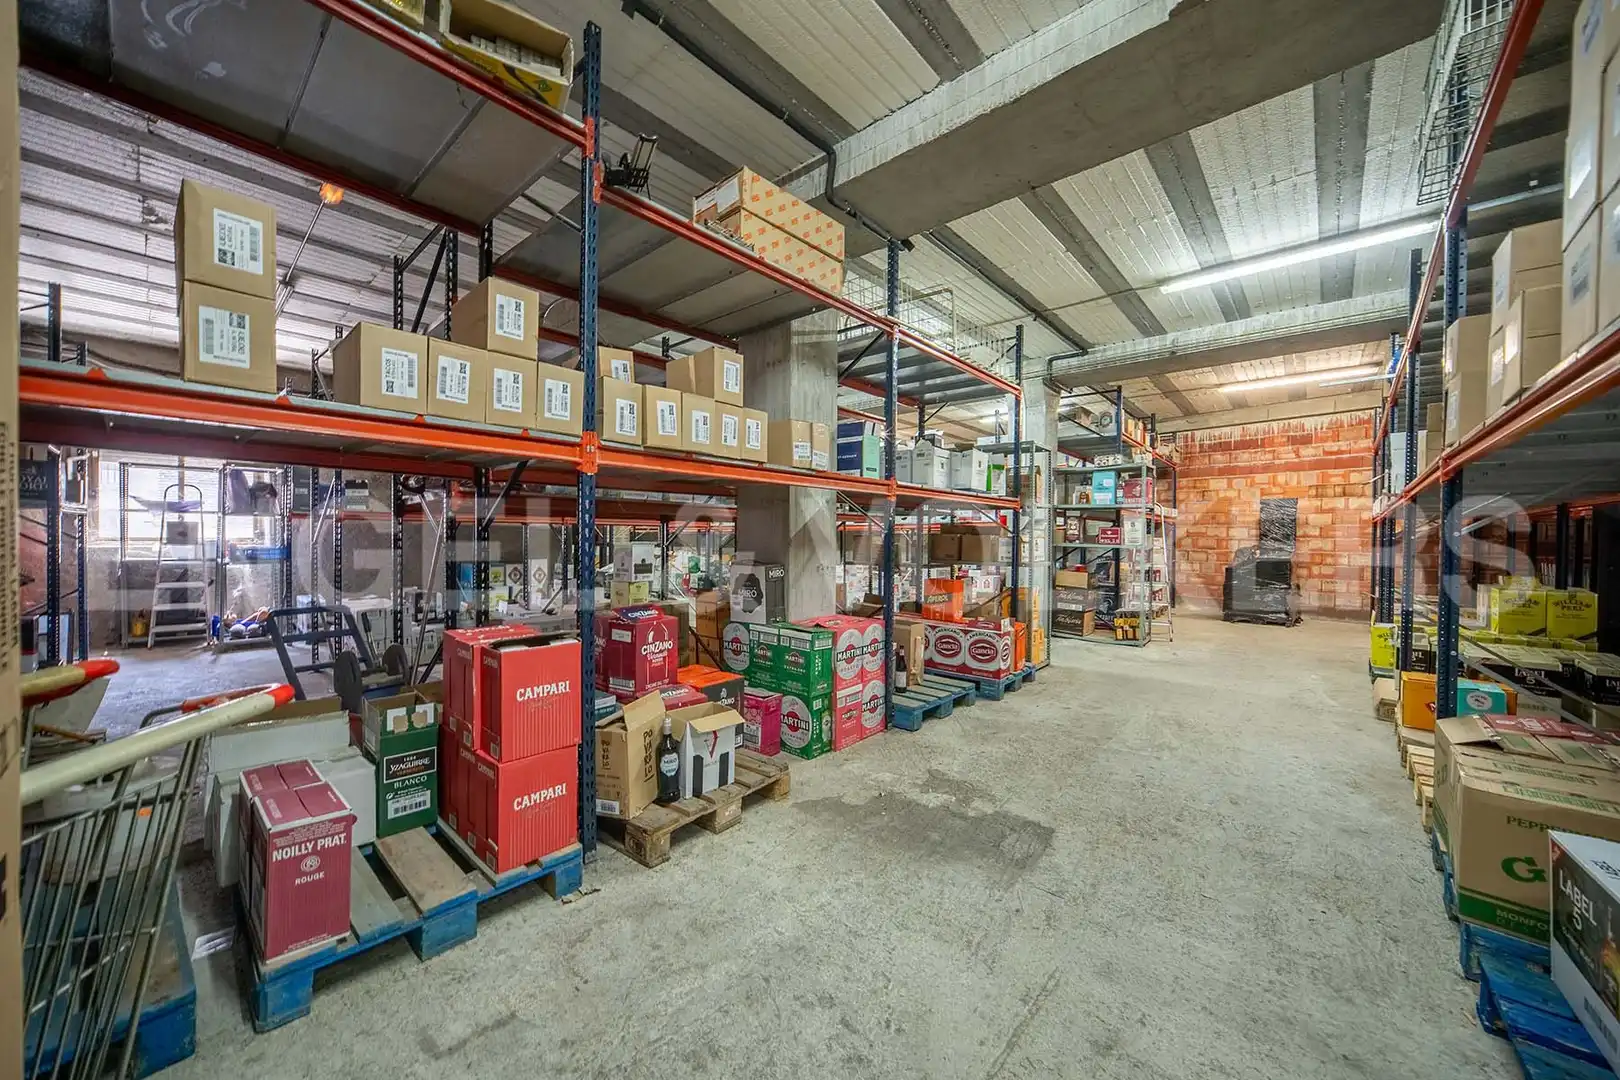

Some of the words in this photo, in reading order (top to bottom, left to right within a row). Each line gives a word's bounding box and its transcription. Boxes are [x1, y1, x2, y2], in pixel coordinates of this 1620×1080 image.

[641, 640, 674, 656] CINZANO
[724, 641, 750, 653] MARTINI
[937, 642, 959, 650] Gancia
[972, 647, 995, 655] Gancia
[837, 648, 862, 662] MARTINI
[516, 680, 570, 702] CAMPARI
[389, 757, 431, 774] YZAGUIRRE
[394, 775, 427, 789] BLANCO
[513, 782, 567, 812] CAMPARI
[272, 841, 315, 862] NOILLY
[295, 871, 325, 885] ROUGE
[1559, 868, 1597, 926] LABEL
[1573, 906, 1583, 931] 5
